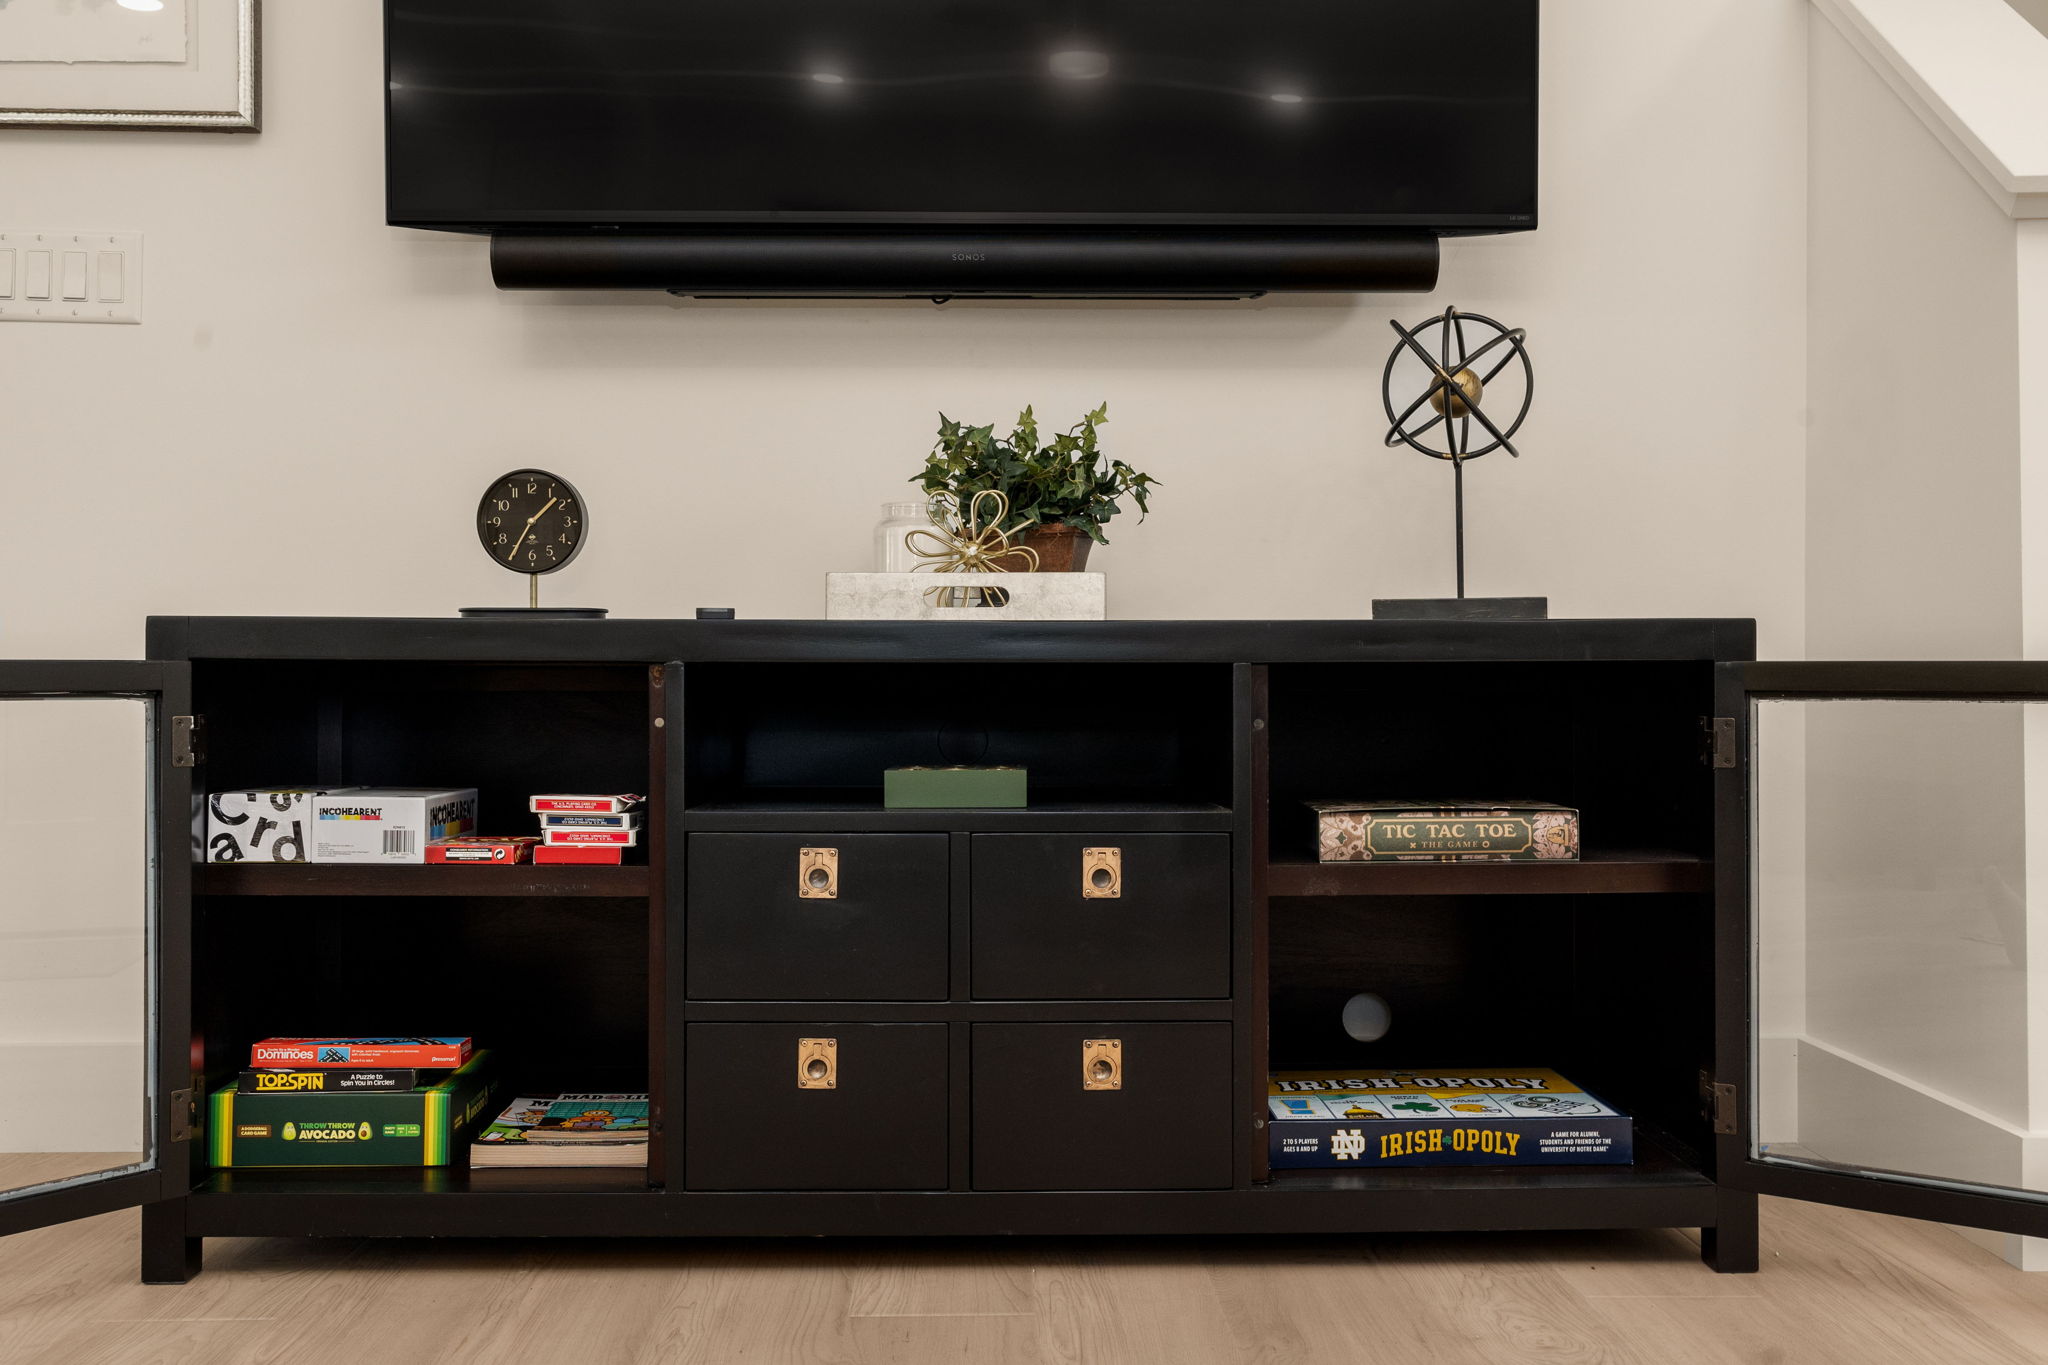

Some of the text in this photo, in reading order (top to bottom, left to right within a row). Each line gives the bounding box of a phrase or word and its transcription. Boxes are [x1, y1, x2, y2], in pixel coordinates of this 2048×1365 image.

[952, 253, 985, 261] SONOS
[512, 488, 518, 498] 11
[528, 483, 537, 494] 12
[498, 500, 510, 511] 10
[558, 499, 566, 510] 2
[493, 517, 501, 528] 9
[564, 516, 572, 528] 3
[499, 532, 507, 544] 8
[558, 533, 566, 544] 4
[528, 550, 536, 560] 6
[546, 545, 554, 556] 5
[319, 807, 382, 816] INCOHEARENT
[1382, 823, 1517, 838] TIC TAC TOE
[257, 1048, 314, 1060] Dominoes
[1277, 1077, 1549, 1092] IRISH-OPOLY
[298, 1130, 356, 1140] AVOCADO
[1380, 1129, 1520, 1159] IRISH OPOLY
